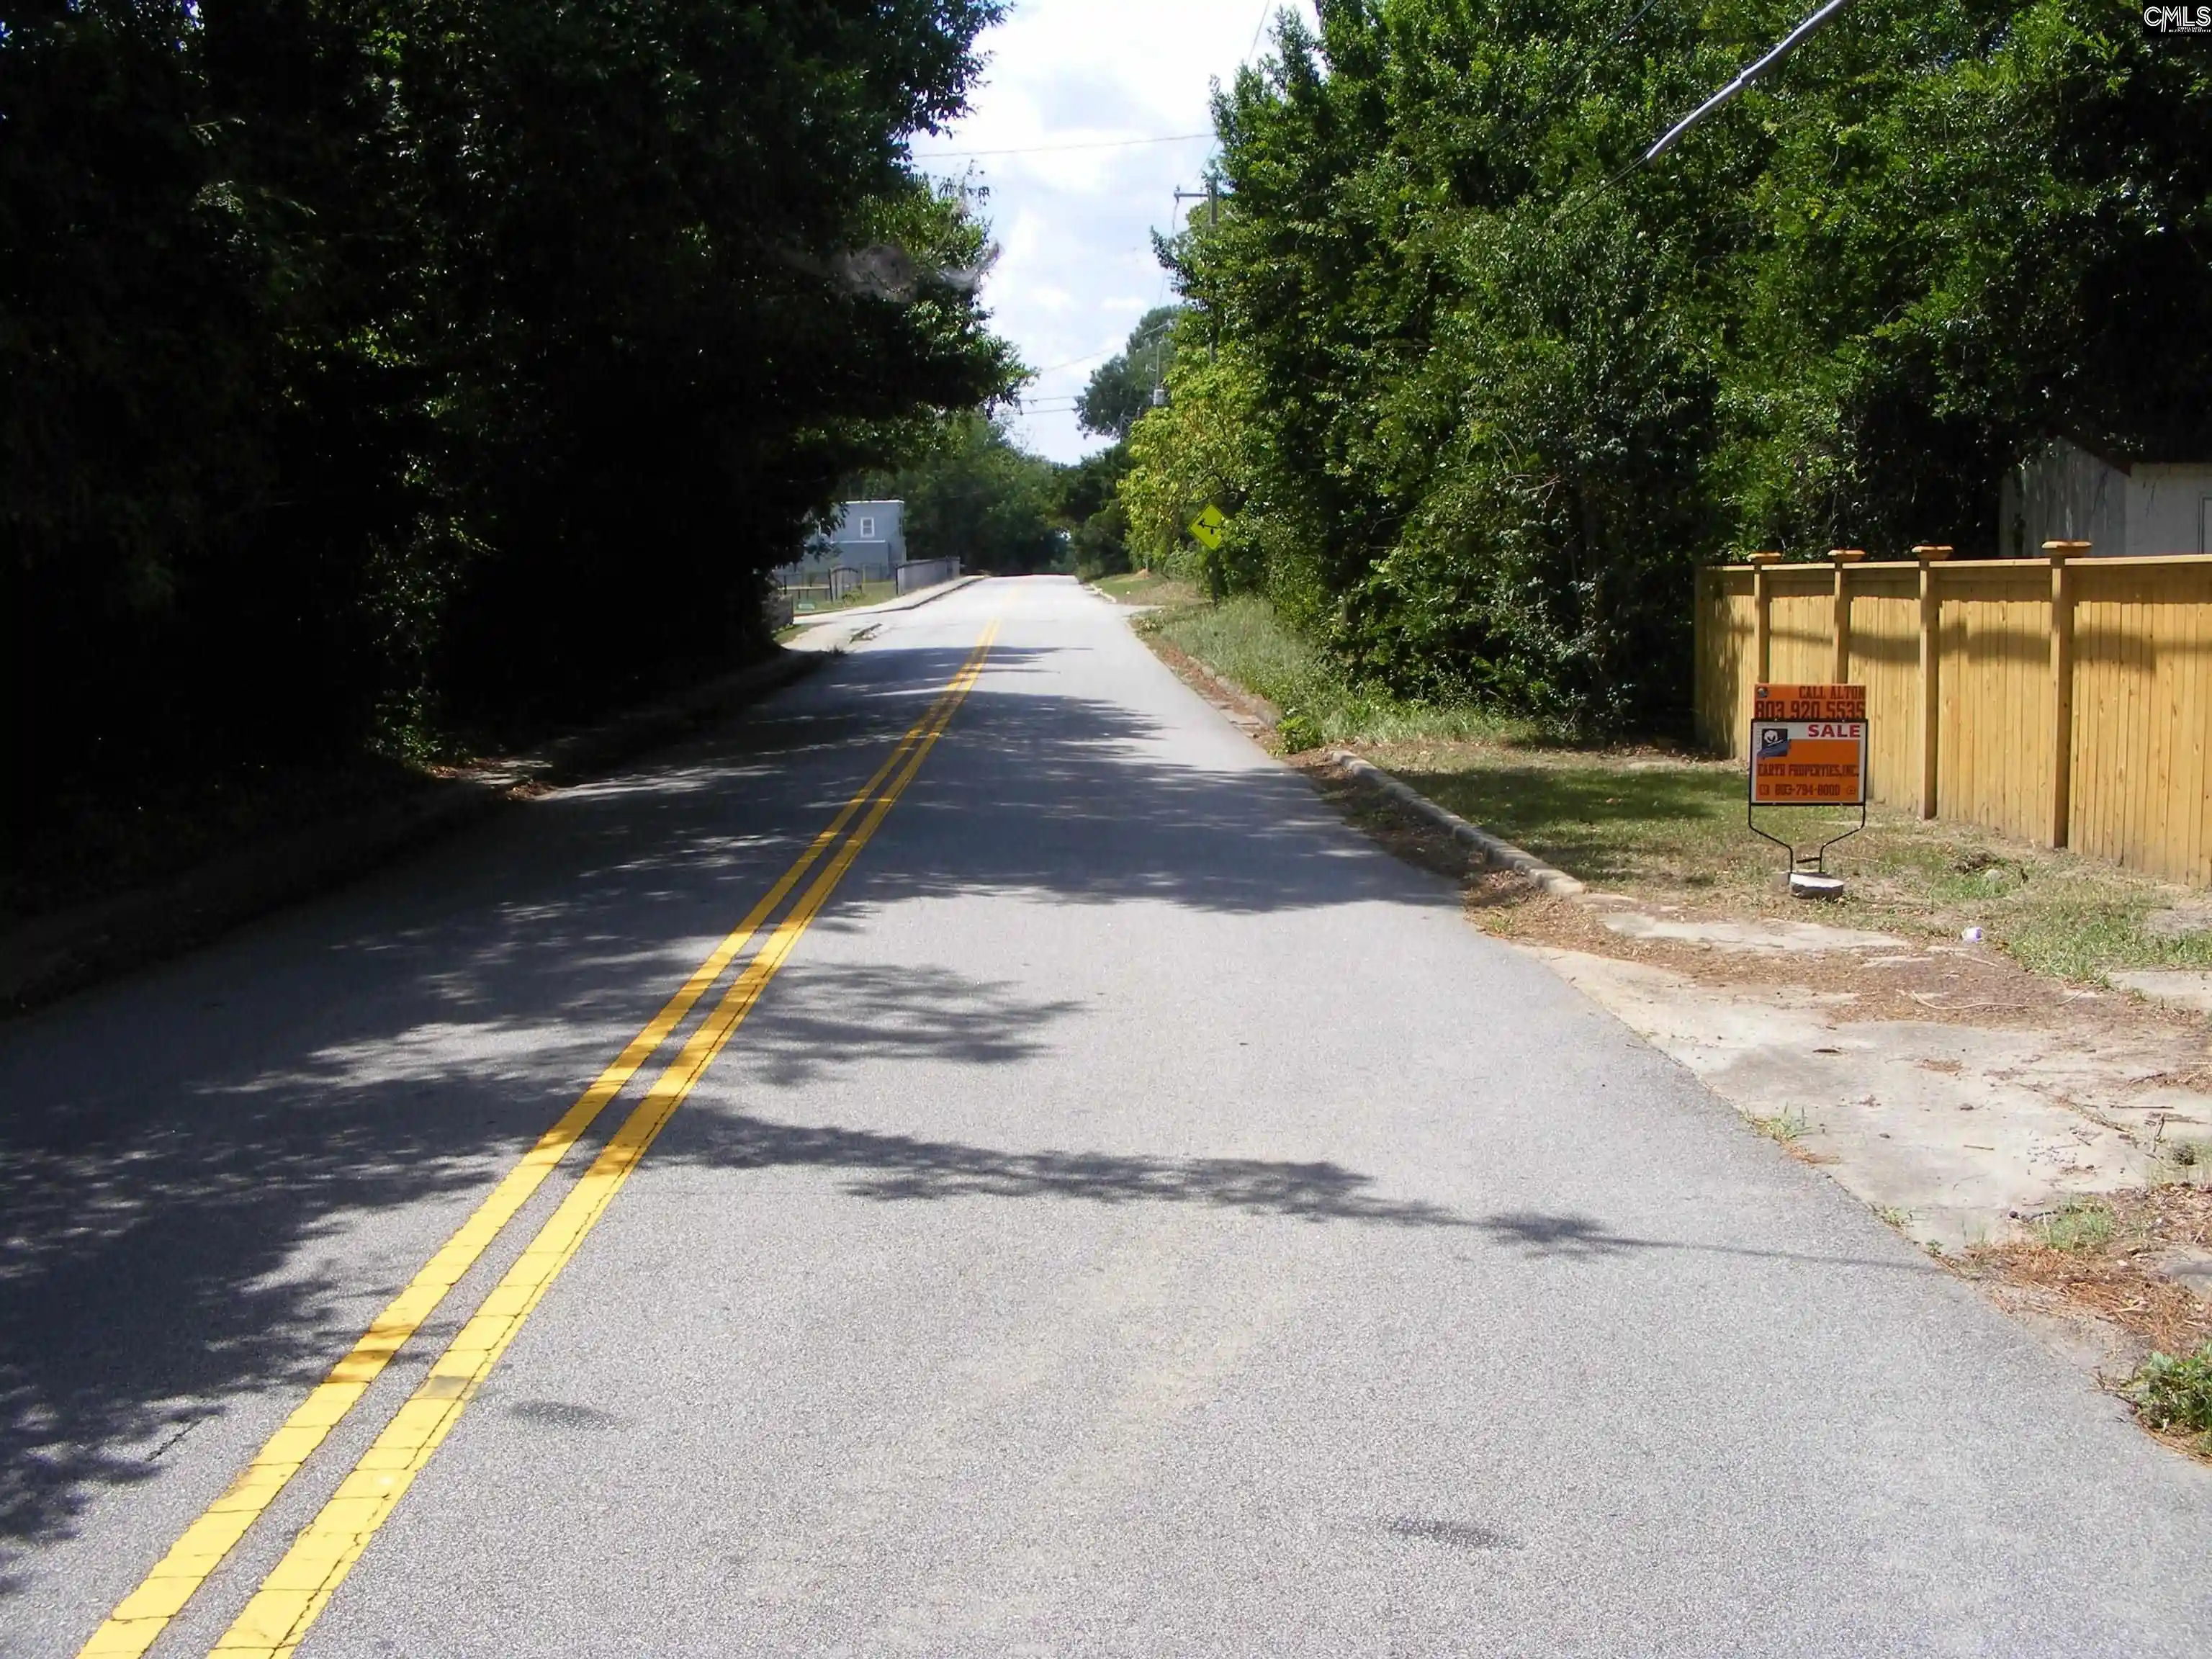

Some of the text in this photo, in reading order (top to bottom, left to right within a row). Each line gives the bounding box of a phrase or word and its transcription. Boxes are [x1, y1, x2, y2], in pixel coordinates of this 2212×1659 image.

[1799, 685, 1866, 699] CALL ALTON
[1755, 700, 1866, 719] 803 920 5535
[1808, 724, 1861, 737] SALE
[1758, 763, 1785, 776] EARTH
